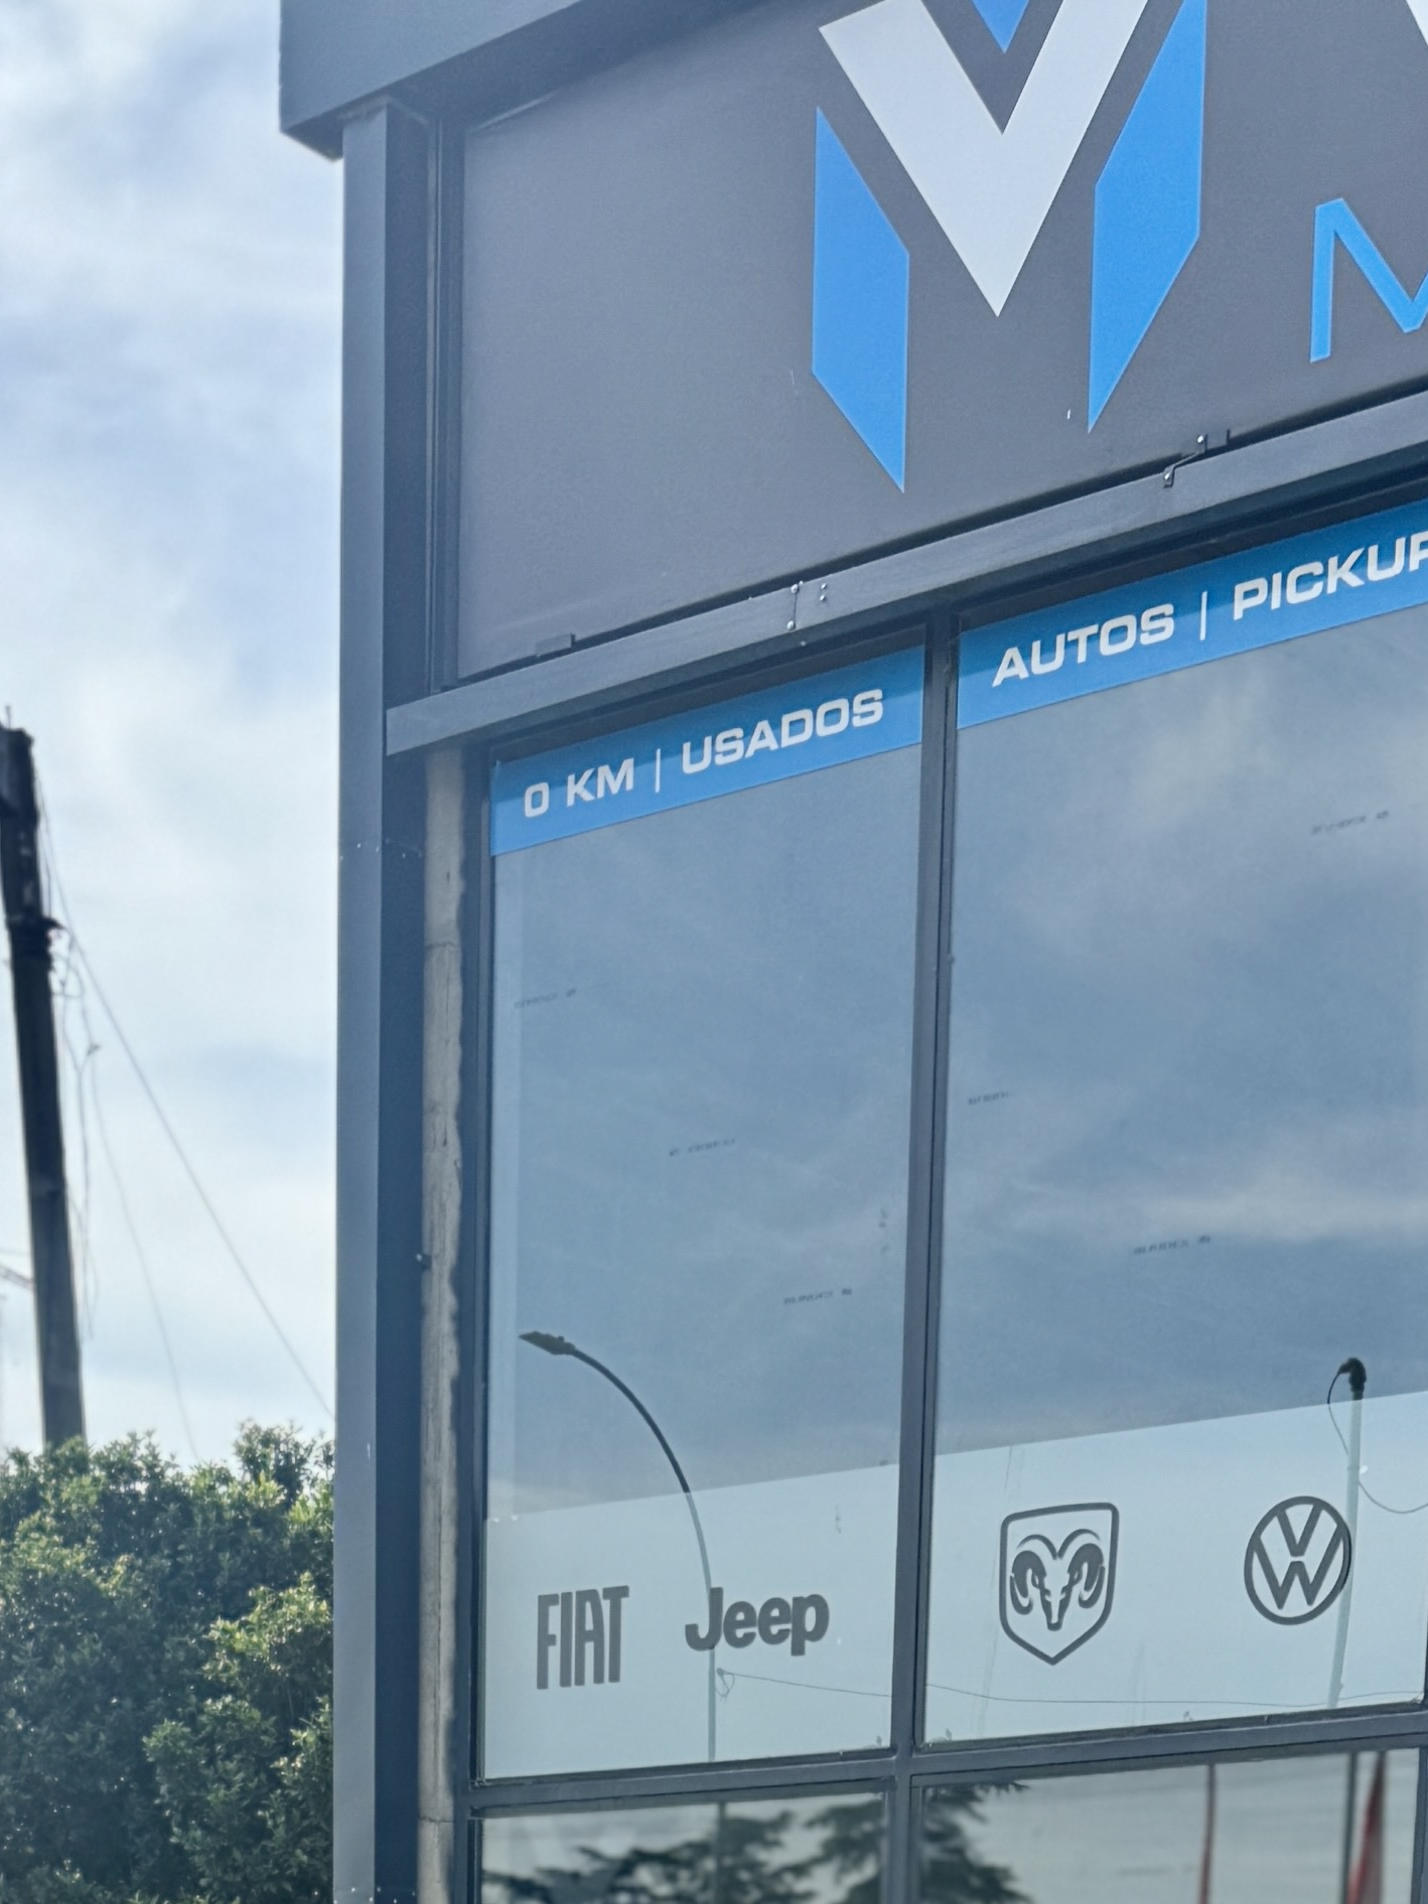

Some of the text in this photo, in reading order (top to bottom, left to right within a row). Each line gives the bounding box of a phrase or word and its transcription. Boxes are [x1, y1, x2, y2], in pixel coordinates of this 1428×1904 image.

[990, 602, 1174, 688] AUTOS
[565, 757, 635, 808] KM
[680, 688, 885, 775] USADOS
[536, 1585, 630, 1690] FIAT
[684, 1586, 830, 1656] Jeep
